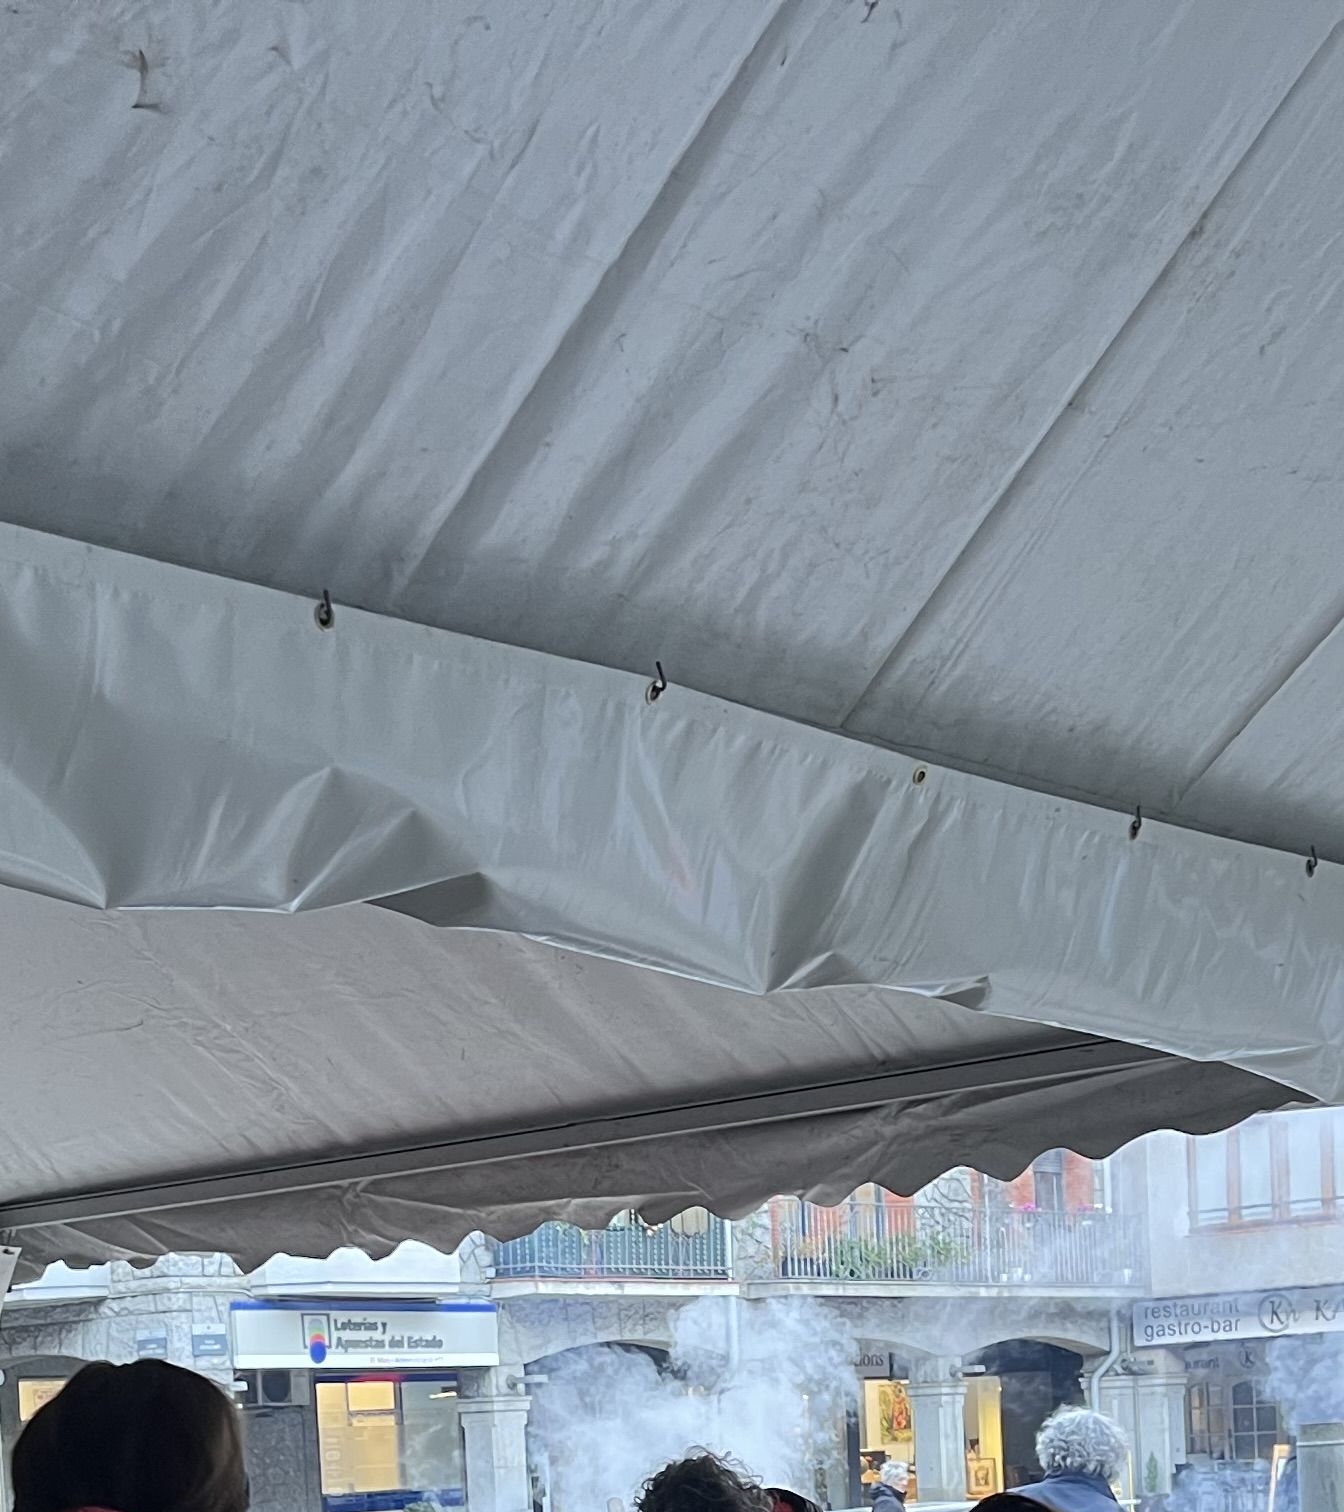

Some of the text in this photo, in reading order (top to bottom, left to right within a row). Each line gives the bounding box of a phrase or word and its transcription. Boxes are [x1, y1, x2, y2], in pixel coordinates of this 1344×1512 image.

[1143, 1298, 1239, 1320] restaurant
[1143, 1318, 1240, 1342] gastro-bar
[389, 1336, 405, 1349] del
[407, 1336, 444, 1349] Estado
